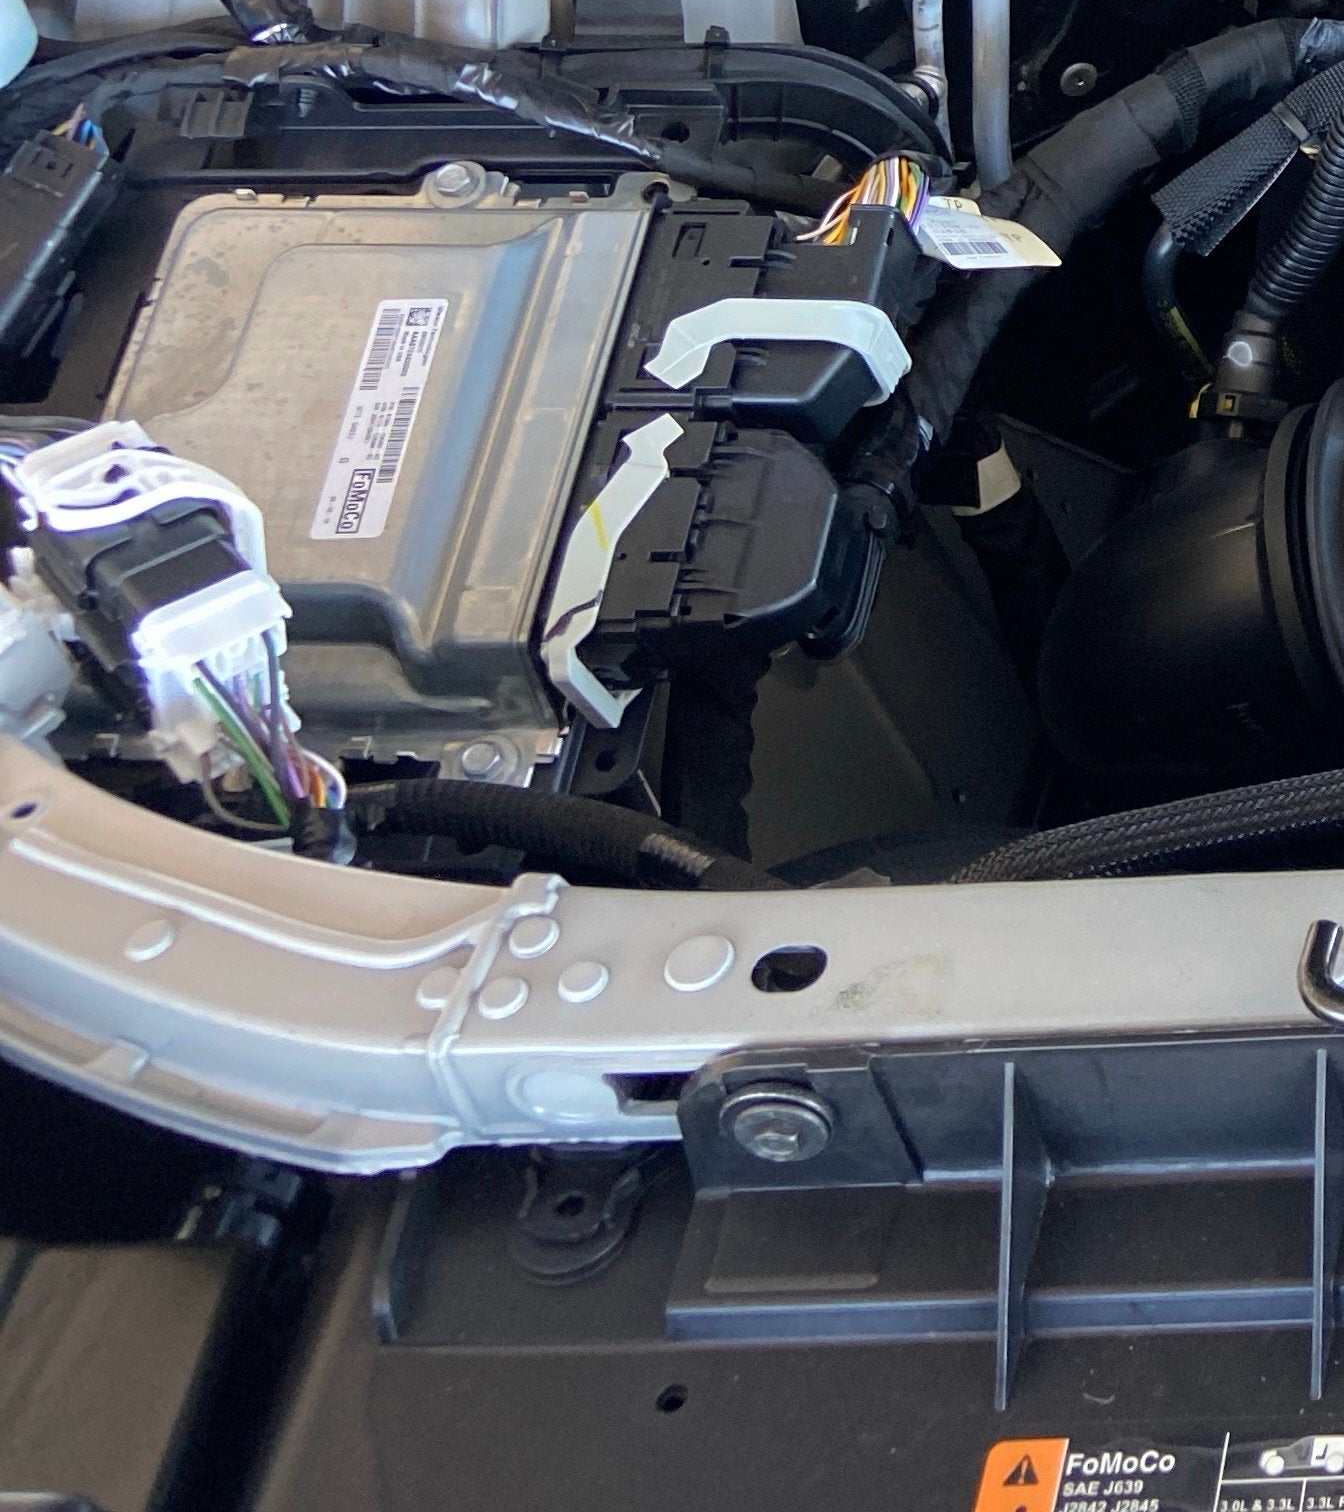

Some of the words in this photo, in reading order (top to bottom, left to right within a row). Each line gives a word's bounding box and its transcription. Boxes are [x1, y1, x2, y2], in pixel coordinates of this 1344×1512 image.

[340, 471, 371, 530] FoMoCo
[1065, 1450, 1175, 1476] FoMoCo
[1062, 1481, 1099, 1497] SAE
[1104, 1480, 1144, 1495] J639
[1058, 1500, 1107, 1512] J2842
[1111, 1498, 1159, 1512] J2845
[1220, 1498, 1248, 1512] 3.0L
[1252, 1500, 1262, 1511] &
[1266, 1497, 1295, 1511] 3.3L
[1307, 1496, 1335, 1509] 3.3L
